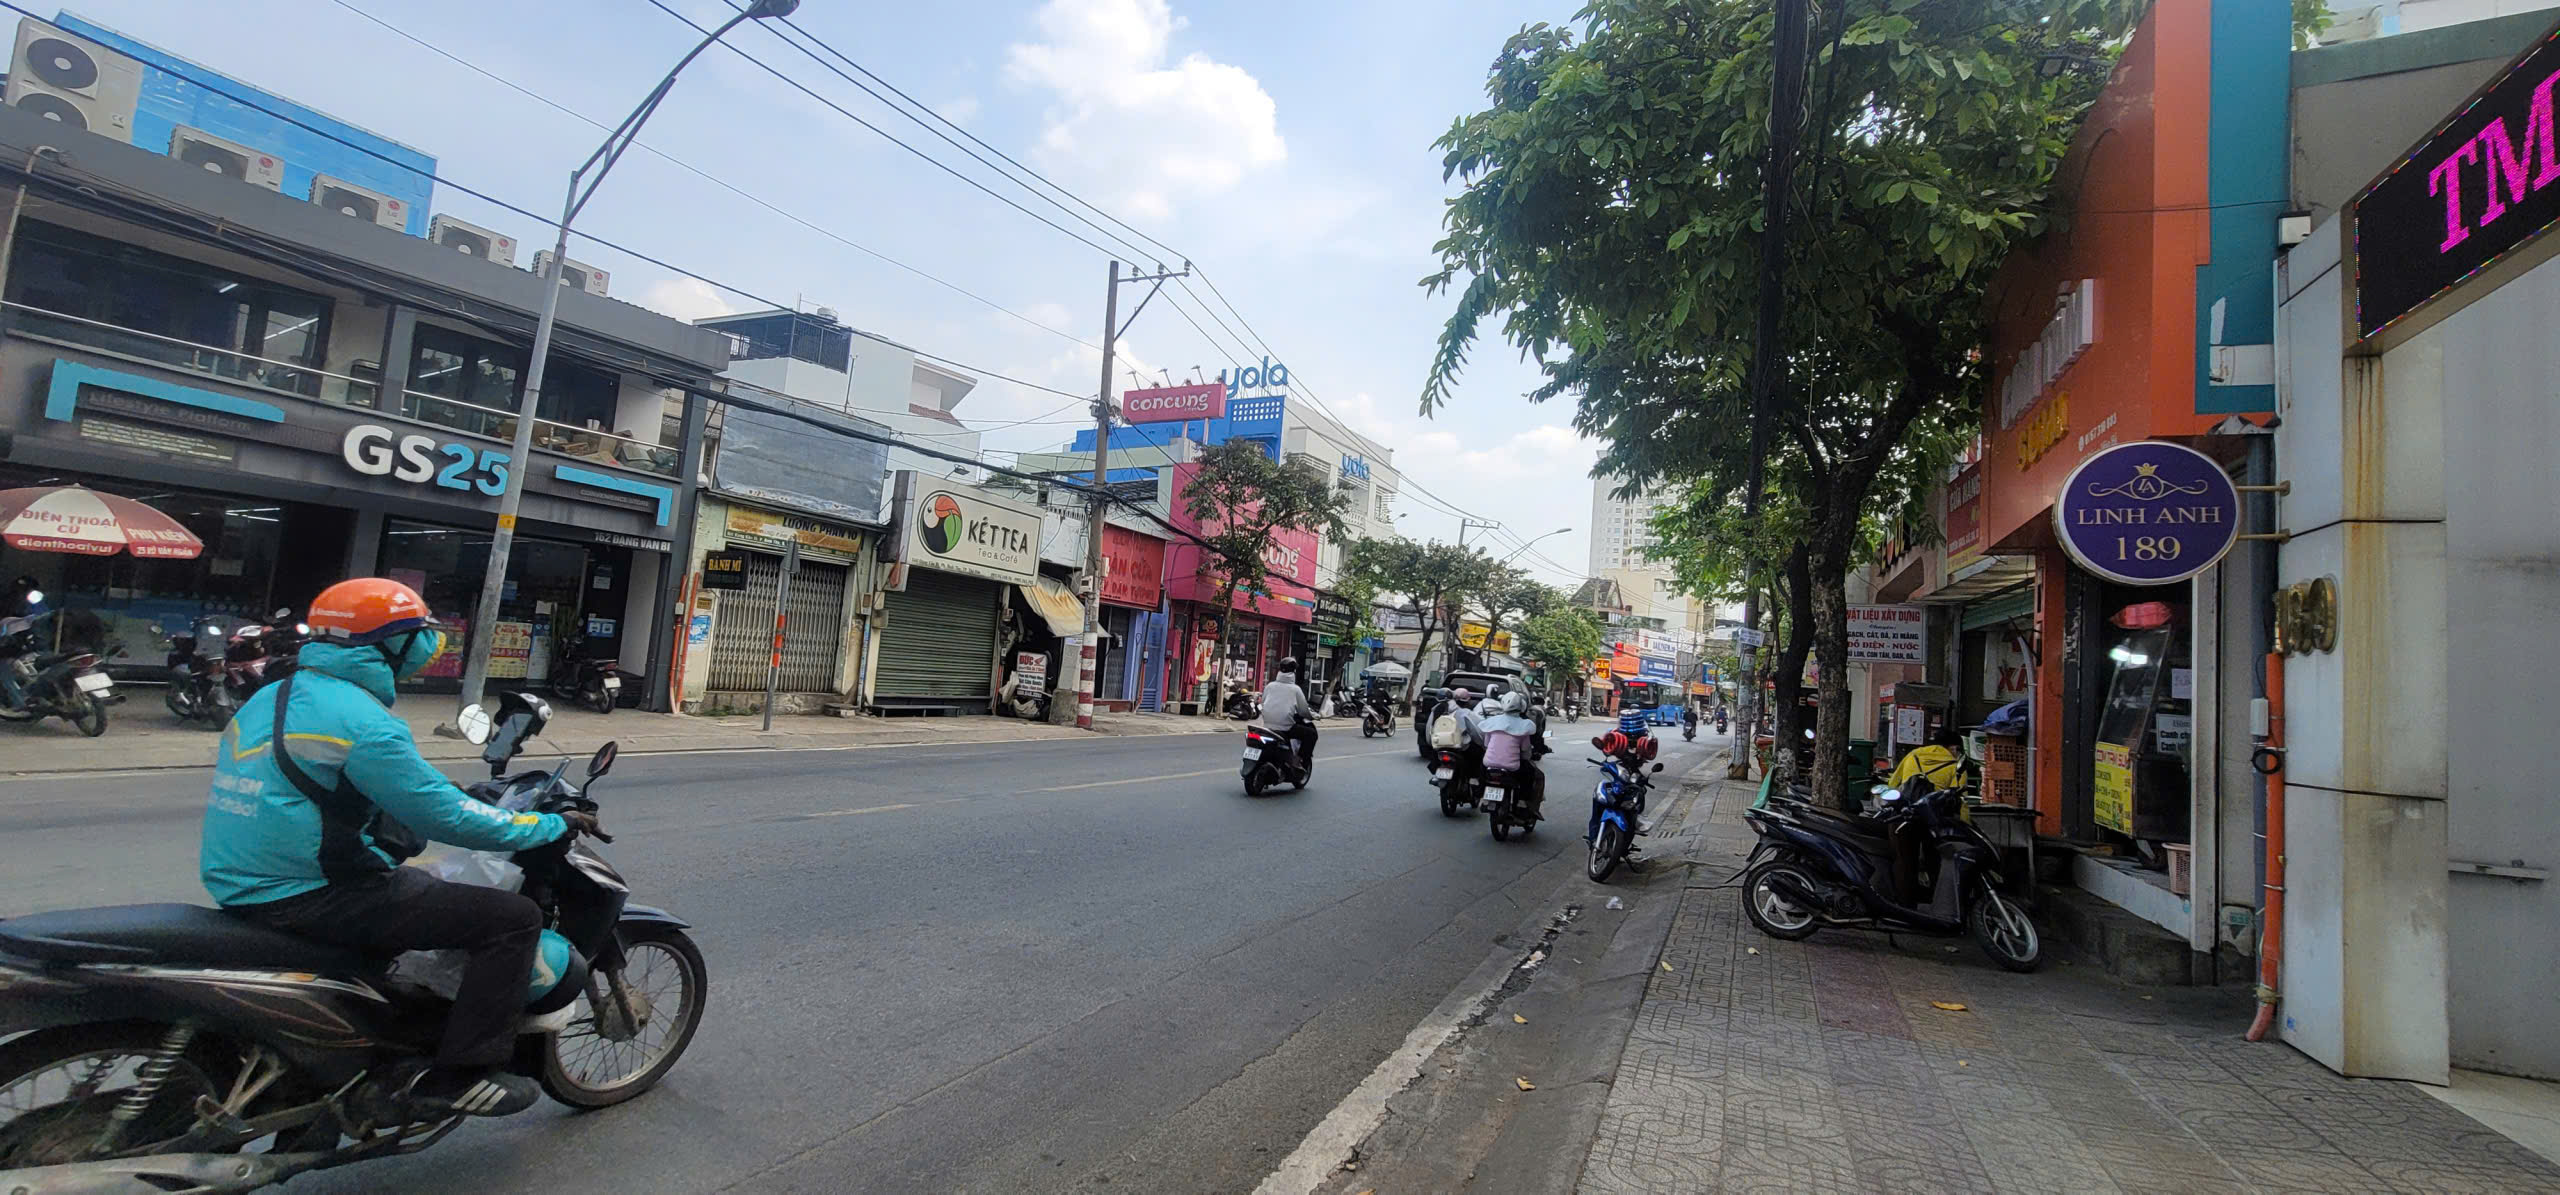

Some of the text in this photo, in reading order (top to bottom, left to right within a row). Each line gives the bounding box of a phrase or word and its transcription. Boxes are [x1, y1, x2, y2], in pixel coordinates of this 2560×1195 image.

[1221, 356, 1289, 399] yola
[1130, 393, 1209, 412] concung
[343, 424, 511, 497] GS25
[1341, 453, 1371, 481] yola
[2077, 507, 2222, 525] LINH ANH
[595, 533, 611, 543] 162
[968, 517, 1028, 555] KÉTTEA
[978, 548, 992, 560] Tea
[2115, 536, 2181, 561] 189
[1847, 608, 1920, 624] VẬT LIỆU XÂY DỰNG
